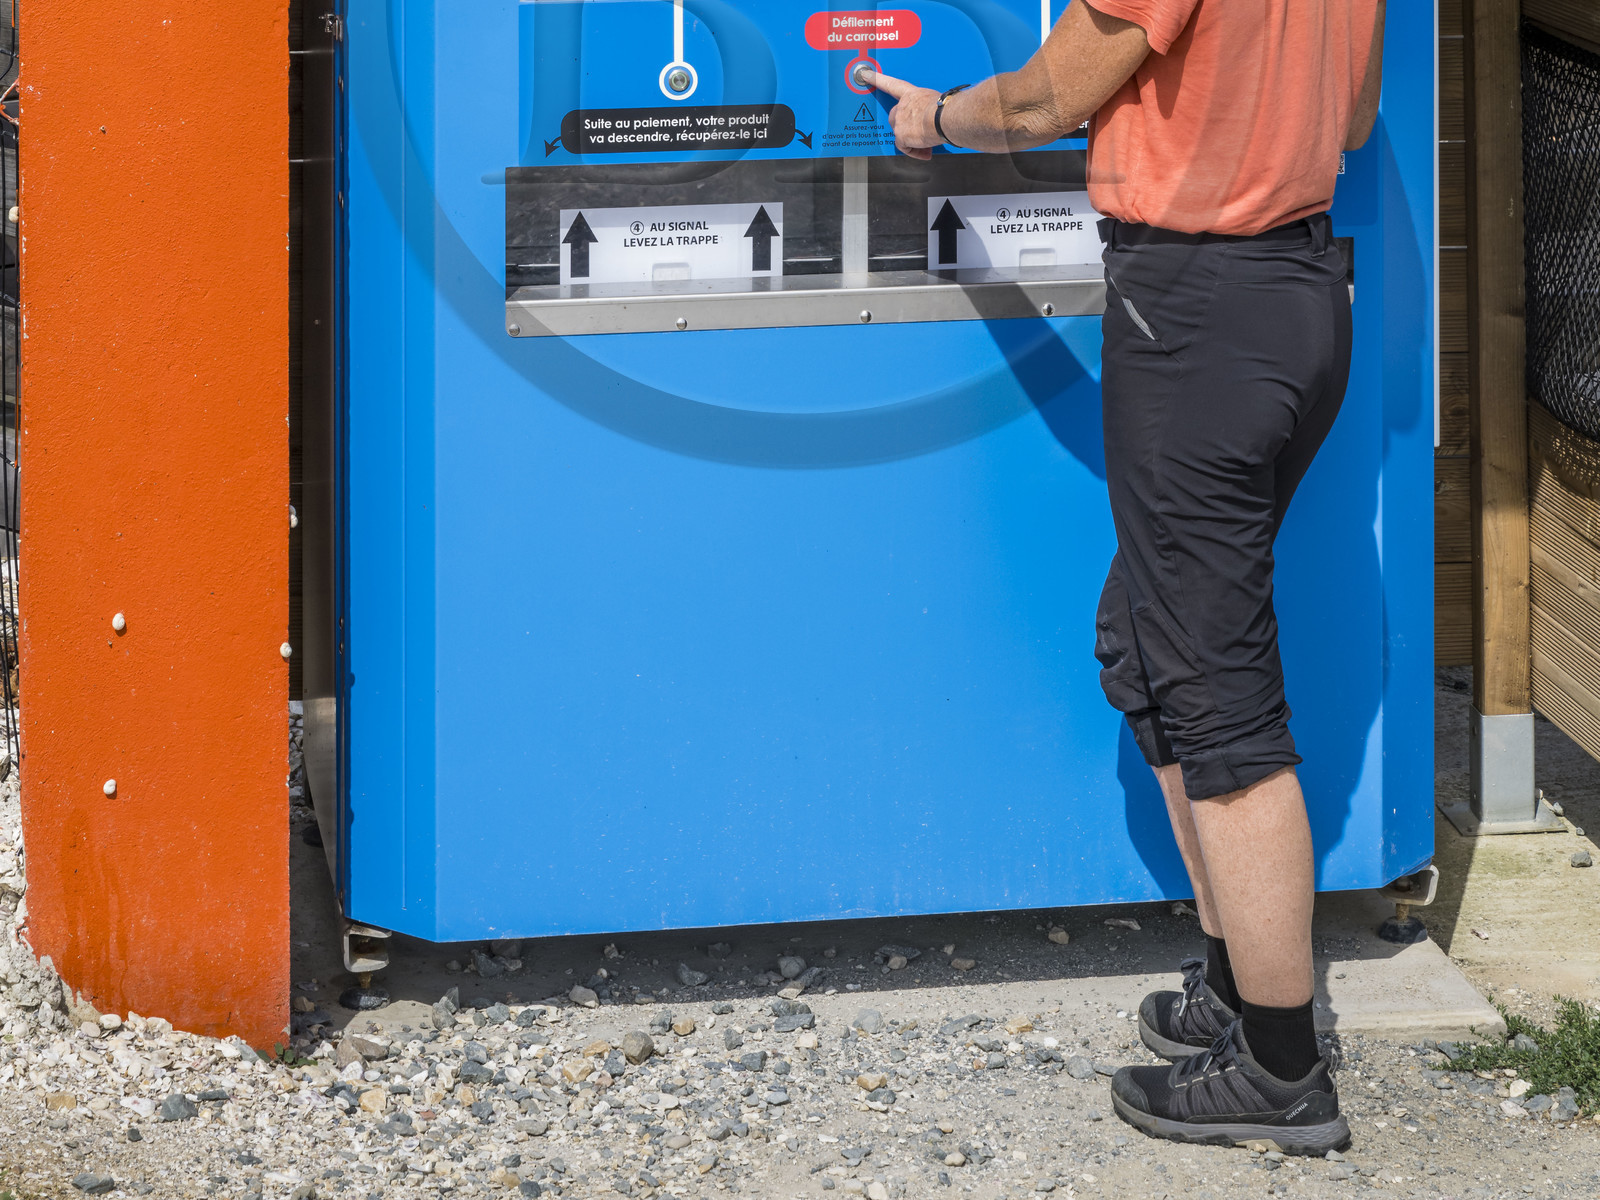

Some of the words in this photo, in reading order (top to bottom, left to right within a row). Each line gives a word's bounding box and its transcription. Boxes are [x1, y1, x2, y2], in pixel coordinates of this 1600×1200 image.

[832, 16, 895, 28] Défilement
[827, 31, 842, 42] du
[845, 30, 899, 42] carrousel
[584, 118, 612, 129] Suite
[615, 120, 630, 129] au
[633, 116, 693, 130] paiement,
[696, 116, 726, 127] votre
[728, 114, 770, 127] produit
[589, 135, 604, 144] va
[607, 131, 674, 143] descendre,
[676, 128, 751, 142] récupérez-le
[753, 128, 768, 139] ici
[822, 132, 844, 140] d'avoir
[845, 132, 857, 140] pris
[851, 140, 875, 148] reposer
[1016, 209, 1031, 219] AU
[1033, 207, 1074, 218] SIGNAL
[649, 222, 666, 232] AU
[668, 220, 710, 231] SIGNAL
[990, 224, 1024, 234] LEVEZ
[1026, 223, 1040, 233] LA
[1041, 221, 1083, 232] TRAPPE
[624, 237, 658, 248] LEVEZ
[660, 236, 674, 246] LA
[676, 234, 719, 246] TRAPPE
